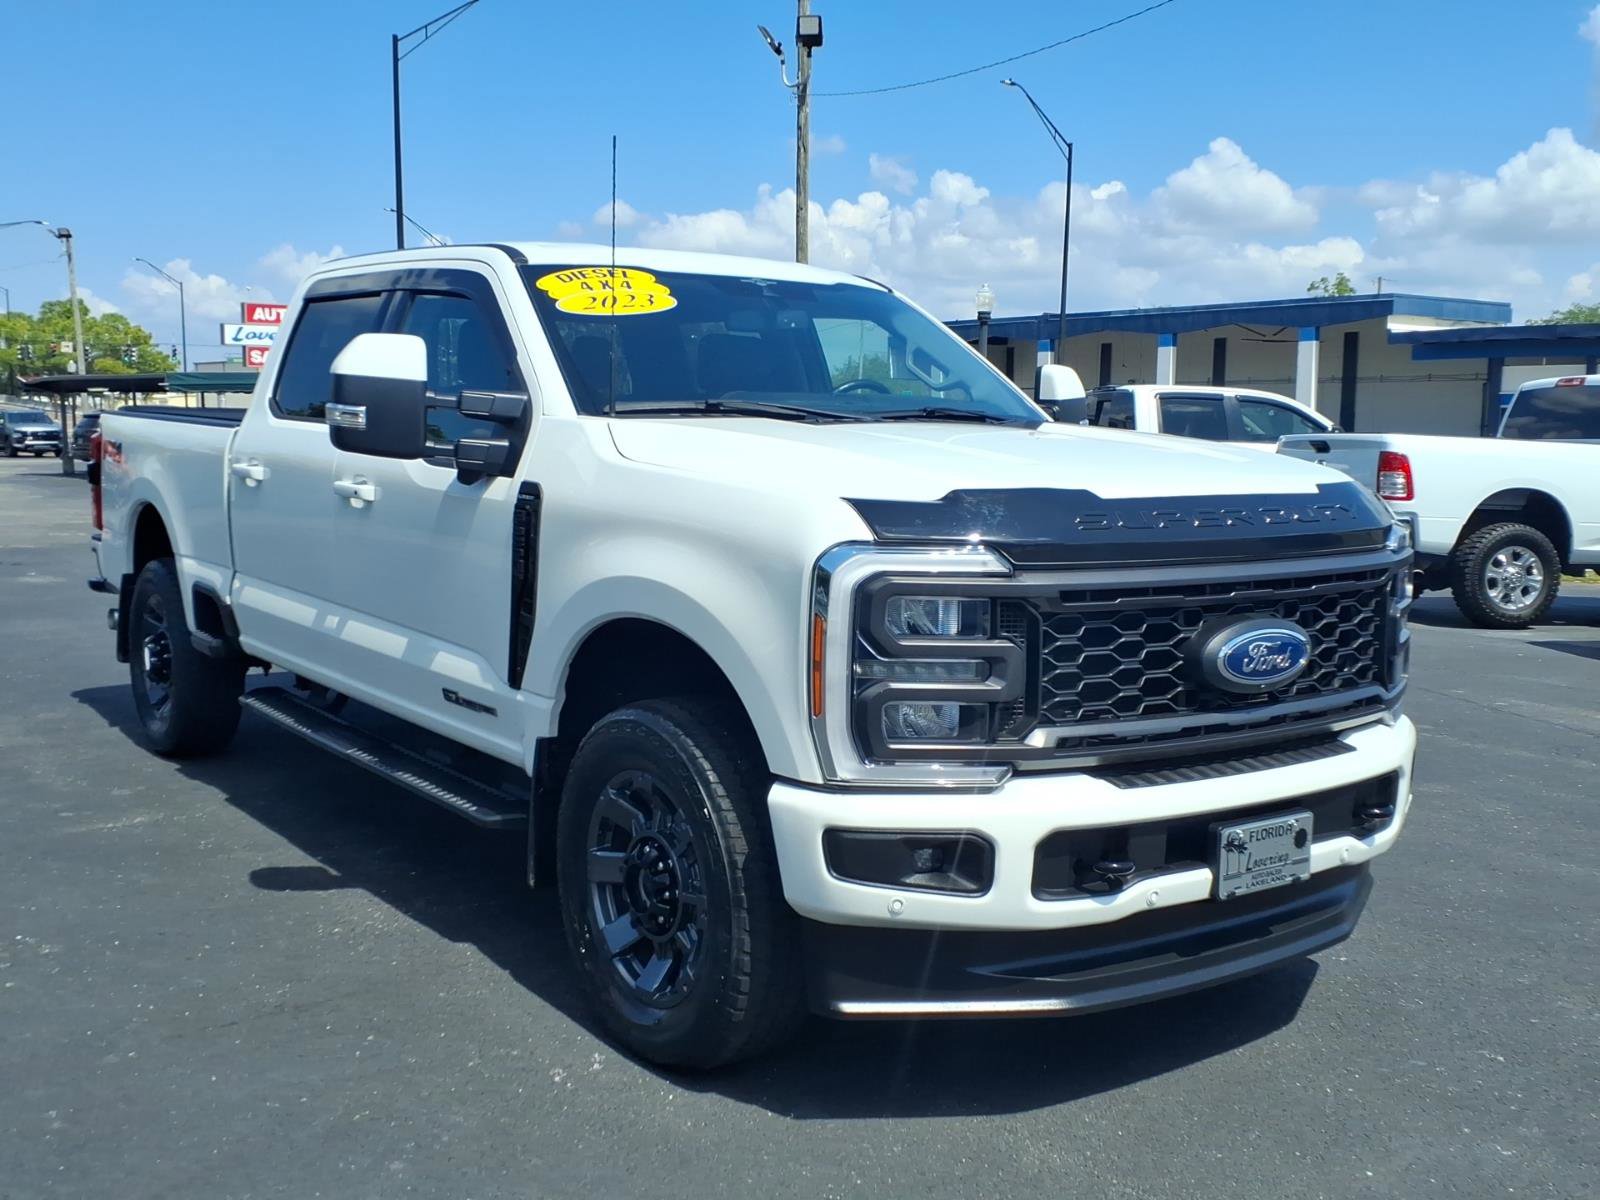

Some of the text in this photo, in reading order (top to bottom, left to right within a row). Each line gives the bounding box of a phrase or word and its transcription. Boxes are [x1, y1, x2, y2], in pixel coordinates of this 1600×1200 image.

[556, 268, 630, 283] DIESEL
[584, 294, 655, 310] 2023
[1242, 641, 1293, 674] Ford
[1249, 823, 1294, 843] FLORIDA
[1246, 874, 1287, 889] LAKELAND
